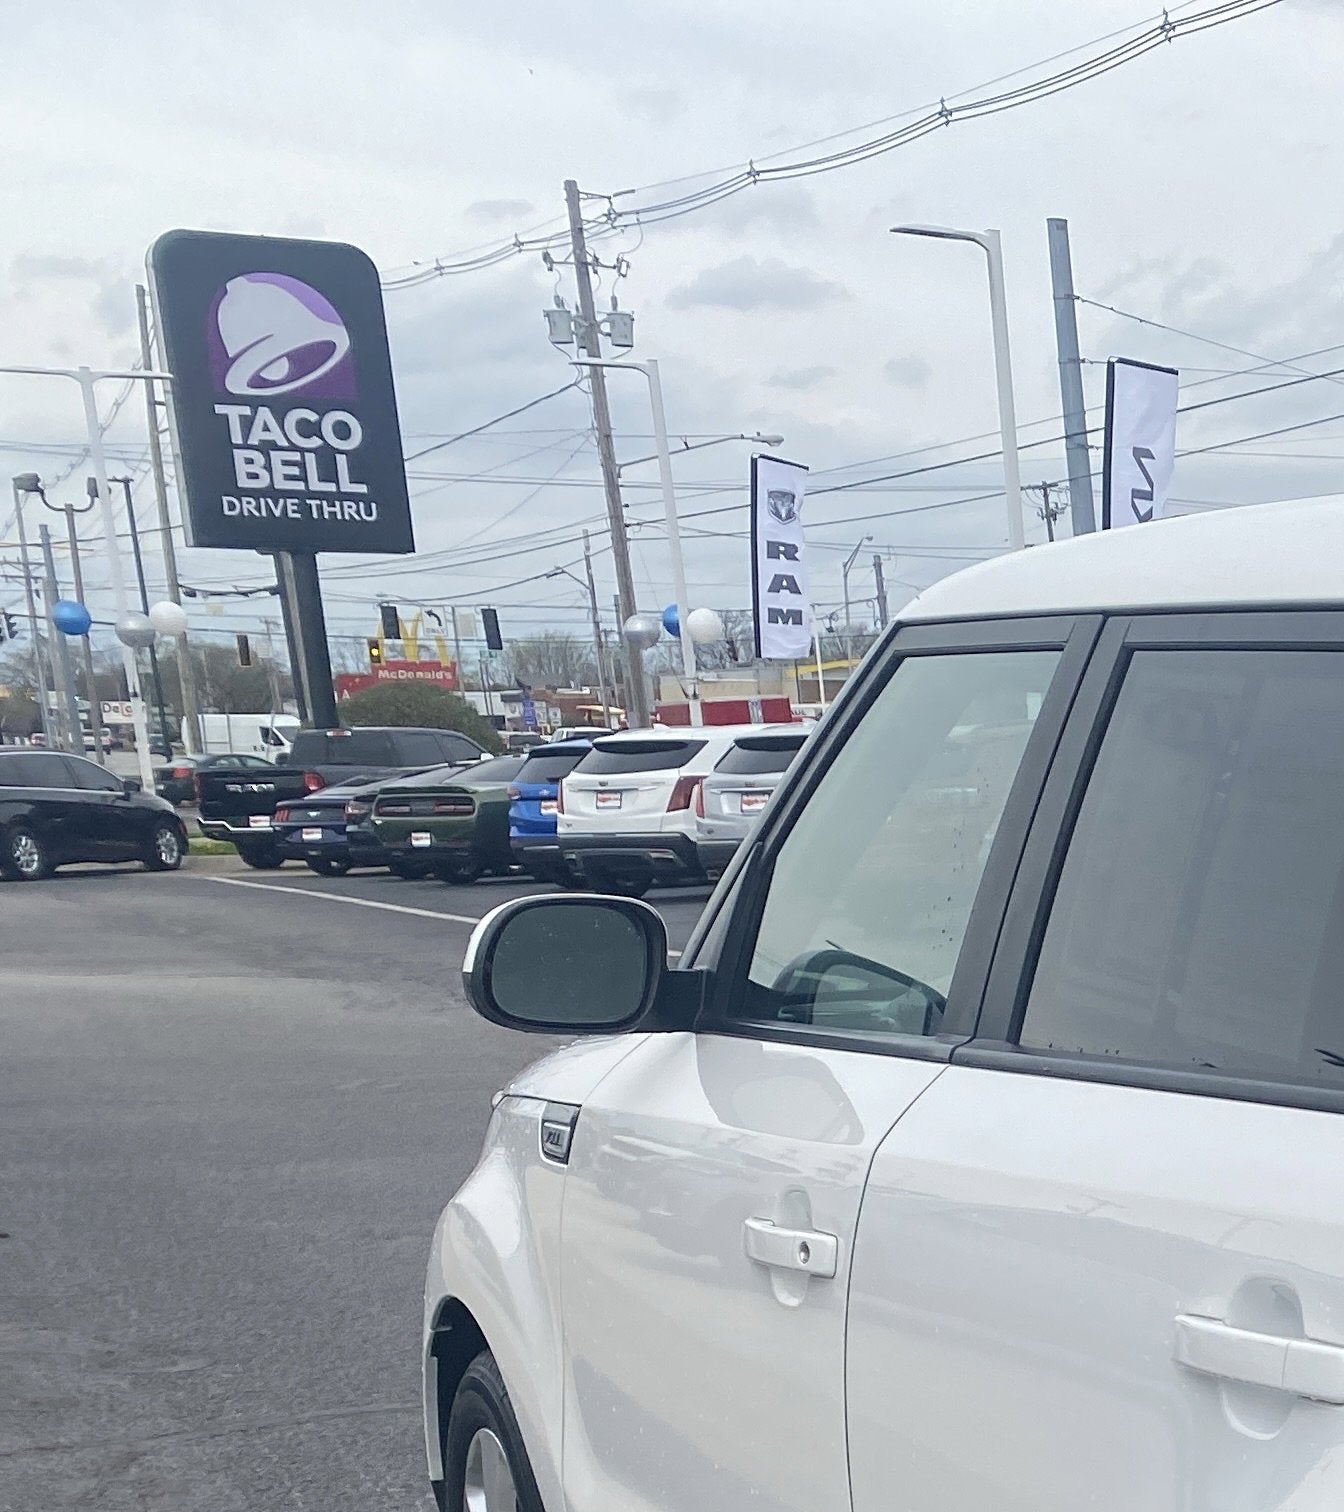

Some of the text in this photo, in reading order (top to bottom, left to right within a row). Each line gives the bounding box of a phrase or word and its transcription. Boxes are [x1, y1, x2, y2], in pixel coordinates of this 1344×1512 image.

[214, 404, 362, 450] TACO
[233, 448, 368, 493] BELL
[222, 495, 377, 521] DRIVE THRU
[766, 540, 803, 626] RAM
[378, 669, 453, 679] McDonald's
